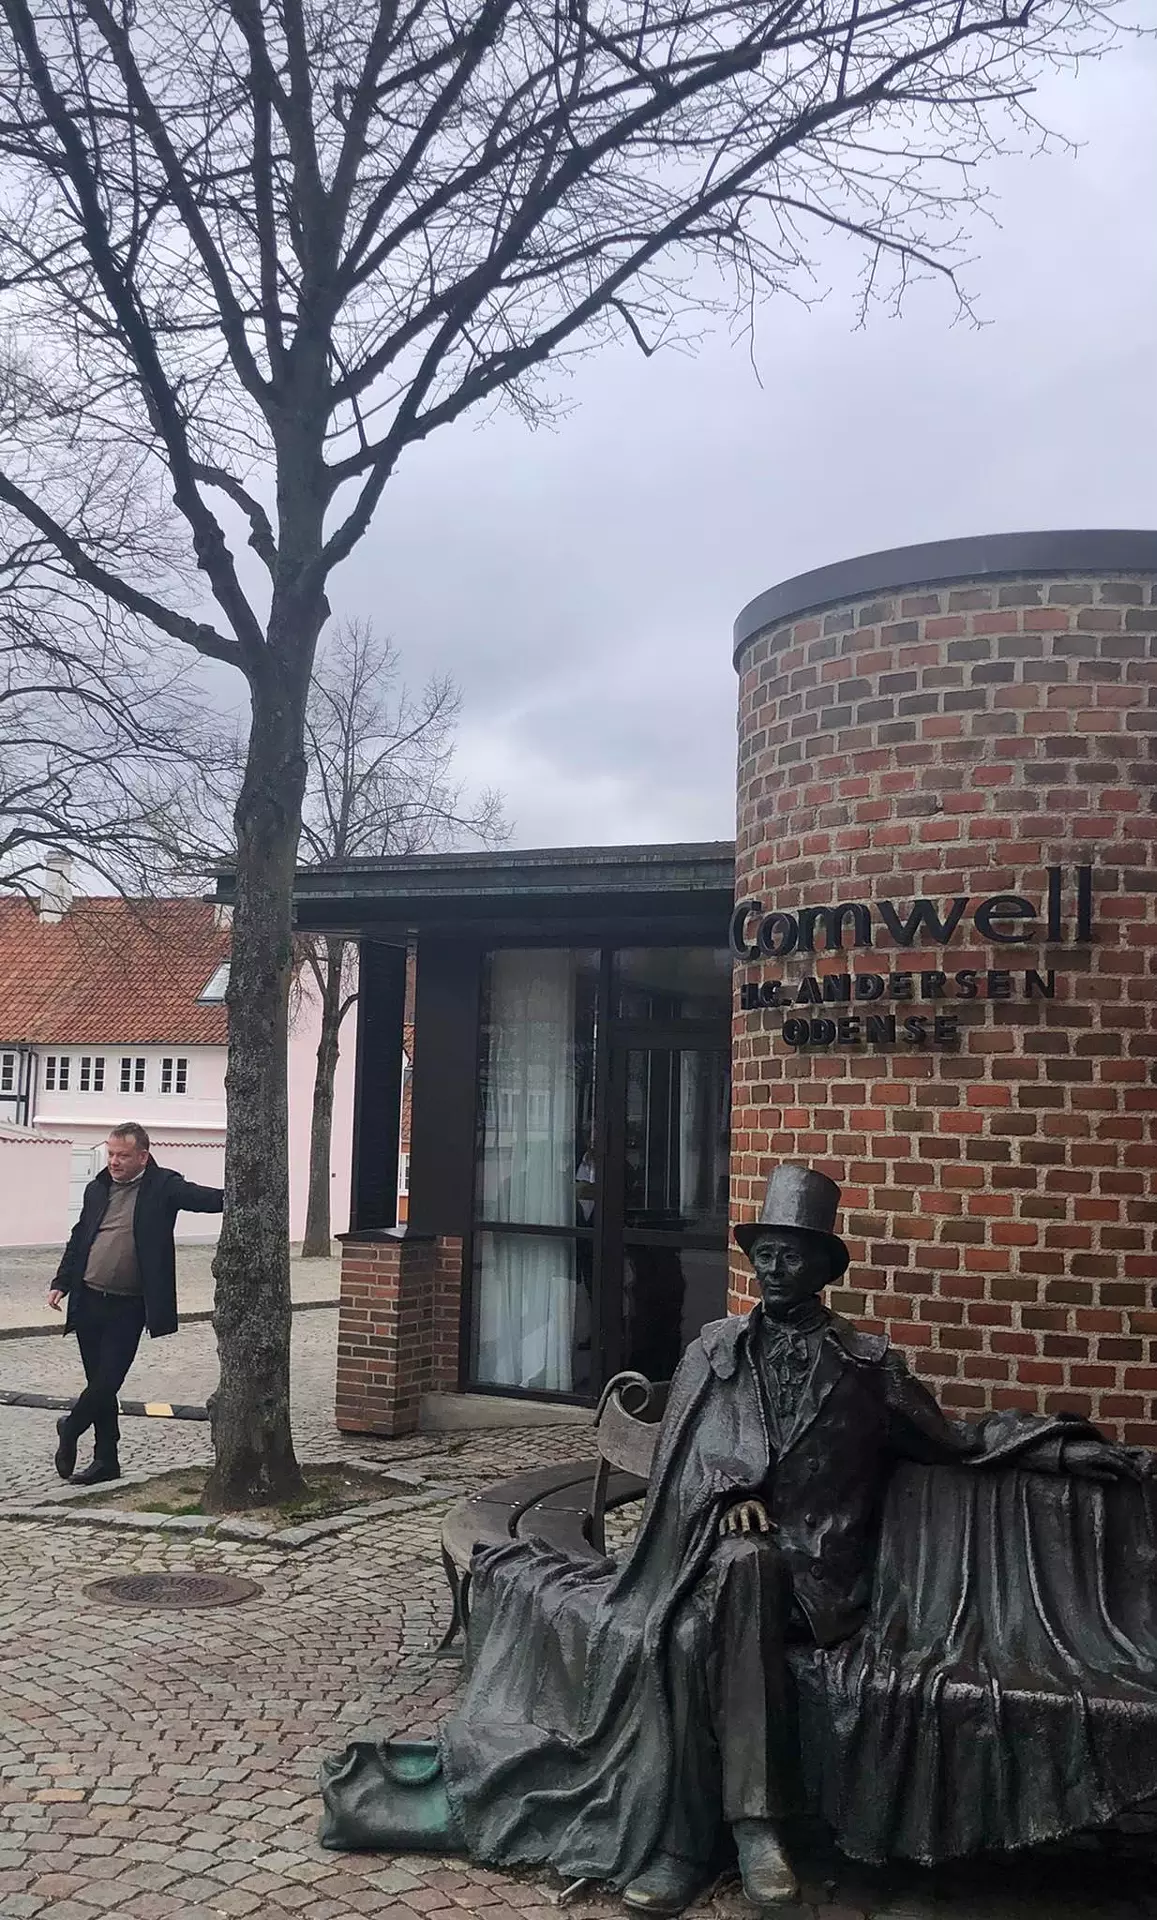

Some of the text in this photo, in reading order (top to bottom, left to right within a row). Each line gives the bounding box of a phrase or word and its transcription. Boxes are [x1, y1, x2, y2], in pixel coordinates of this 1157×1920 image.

[729, 865, 1093, 961] Comwell
[795, 969, 1055, 1005] ANDERSEN
[782, 1015, 959, 1047] ODENSE
